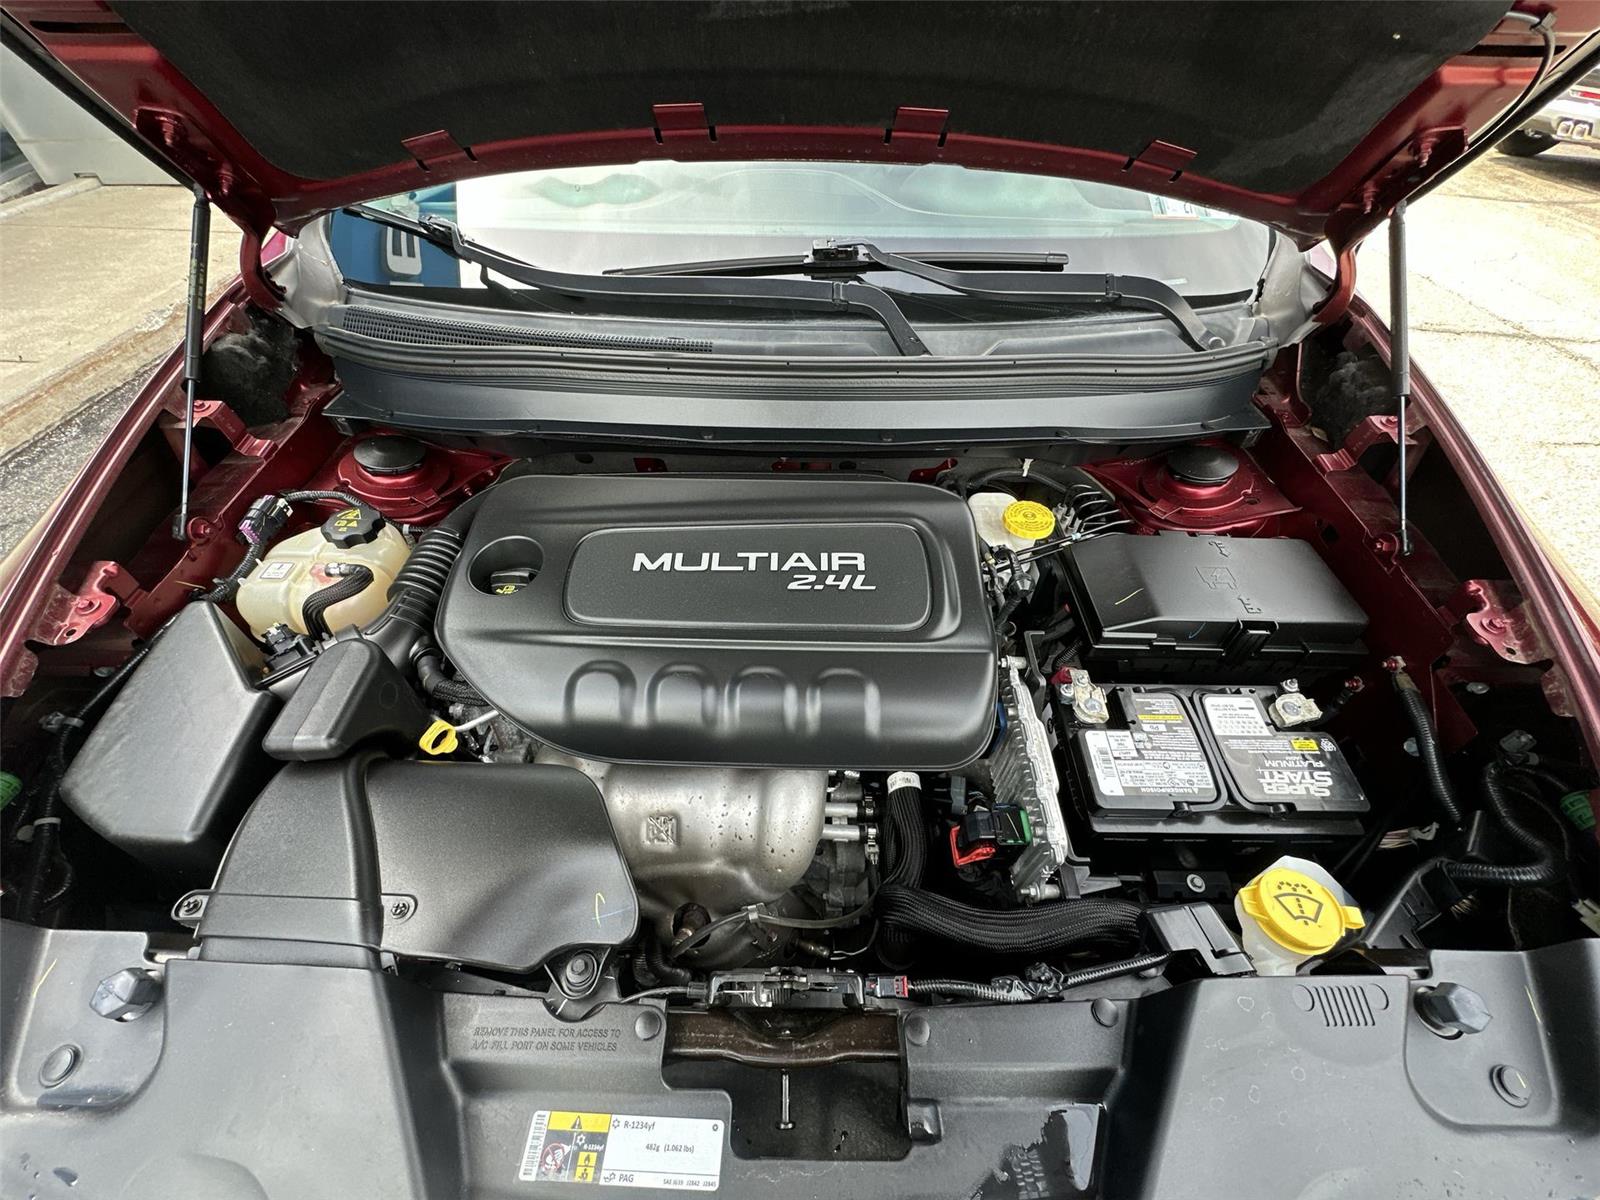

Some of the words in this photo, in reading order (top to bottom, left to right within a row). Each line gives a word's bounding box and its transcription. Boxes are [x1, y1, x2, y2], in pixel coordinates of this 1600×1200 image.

[632, 552, 866, 571] MULTIAIR
[786, 574, 877, 590] 2.4L
[1264, 759, 1324, 768] PLATINUM
[1257, 770, 1333, 785] START
[1262, 783, 1331, 797] SUPER
[473, 1027, 509, 1037] REMOVE
[510, 1027, 529, 1037] THIS
[530, 1027, 557, 1037] PANEL
[558, 1028, 575, 1038] FOR
[576, 1028, 609, 1038] ACCESS
[609, 1028, 621, 1038] TO
[471, 1039, 488, 1050] A/C
[490, 1040, 508, 1050] FILL
[511, 1040, 534, 1050] PORT
[535, 1041, 549, 1051] ON
[550, 1041, 576, 1051] SOME
[577, 1041, 617, 1051] VEHICLES
[623, 1120, 656, 1131] R-1234yf
[663, 1144, 683, 1153] (1.062
[683, 1144, 695, 1154] lbs)
[618, 1175, 634, 1183] PAG
